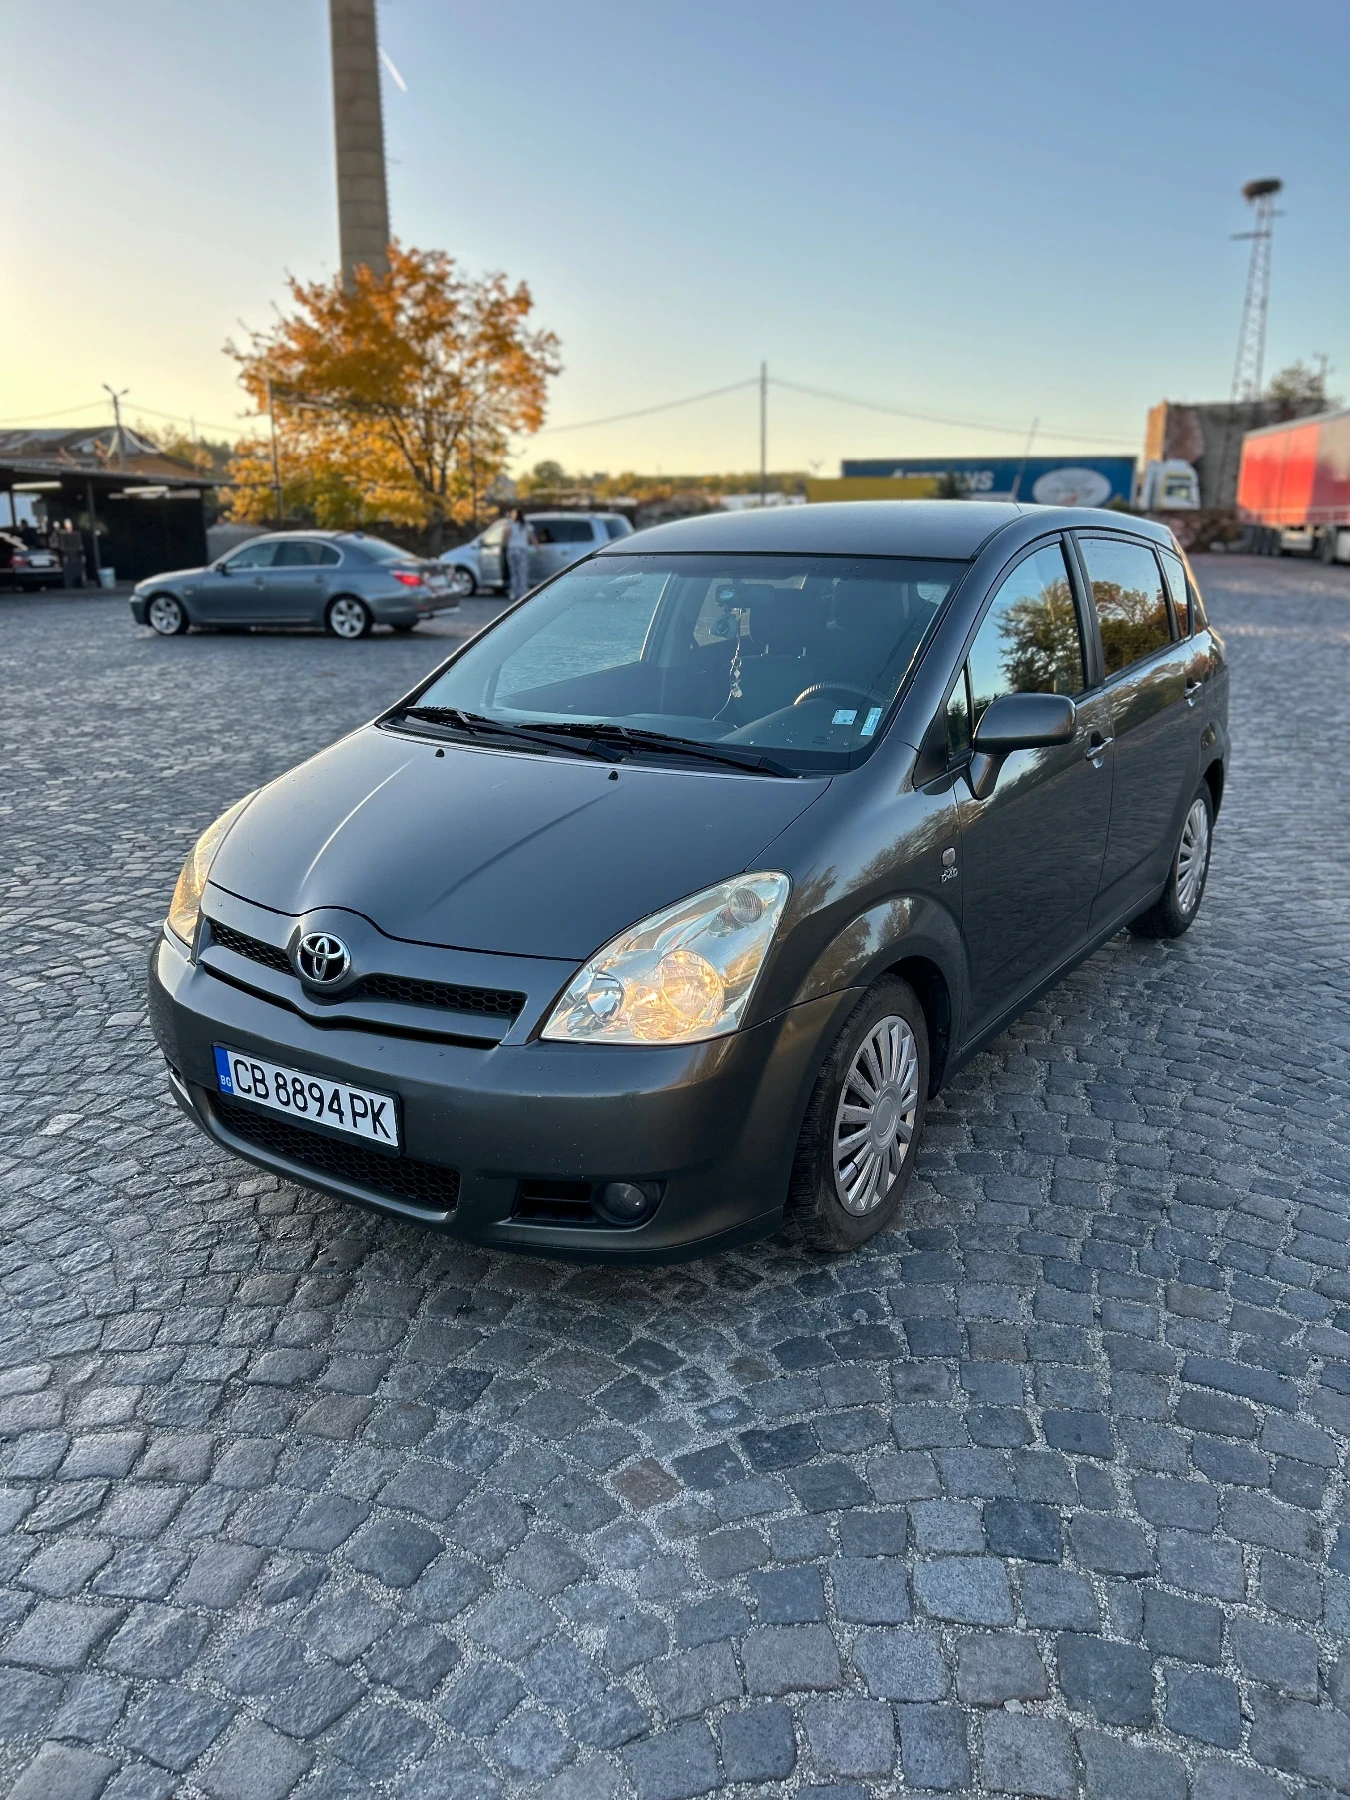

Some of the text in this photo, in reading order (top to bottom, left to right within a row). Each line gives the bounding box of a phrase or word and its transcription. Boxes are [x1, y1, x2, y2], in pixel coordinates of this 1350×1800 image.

[220, 1074, 232, 1087] BG
[233, 1058, 392, 1140] CB 8894 PK
